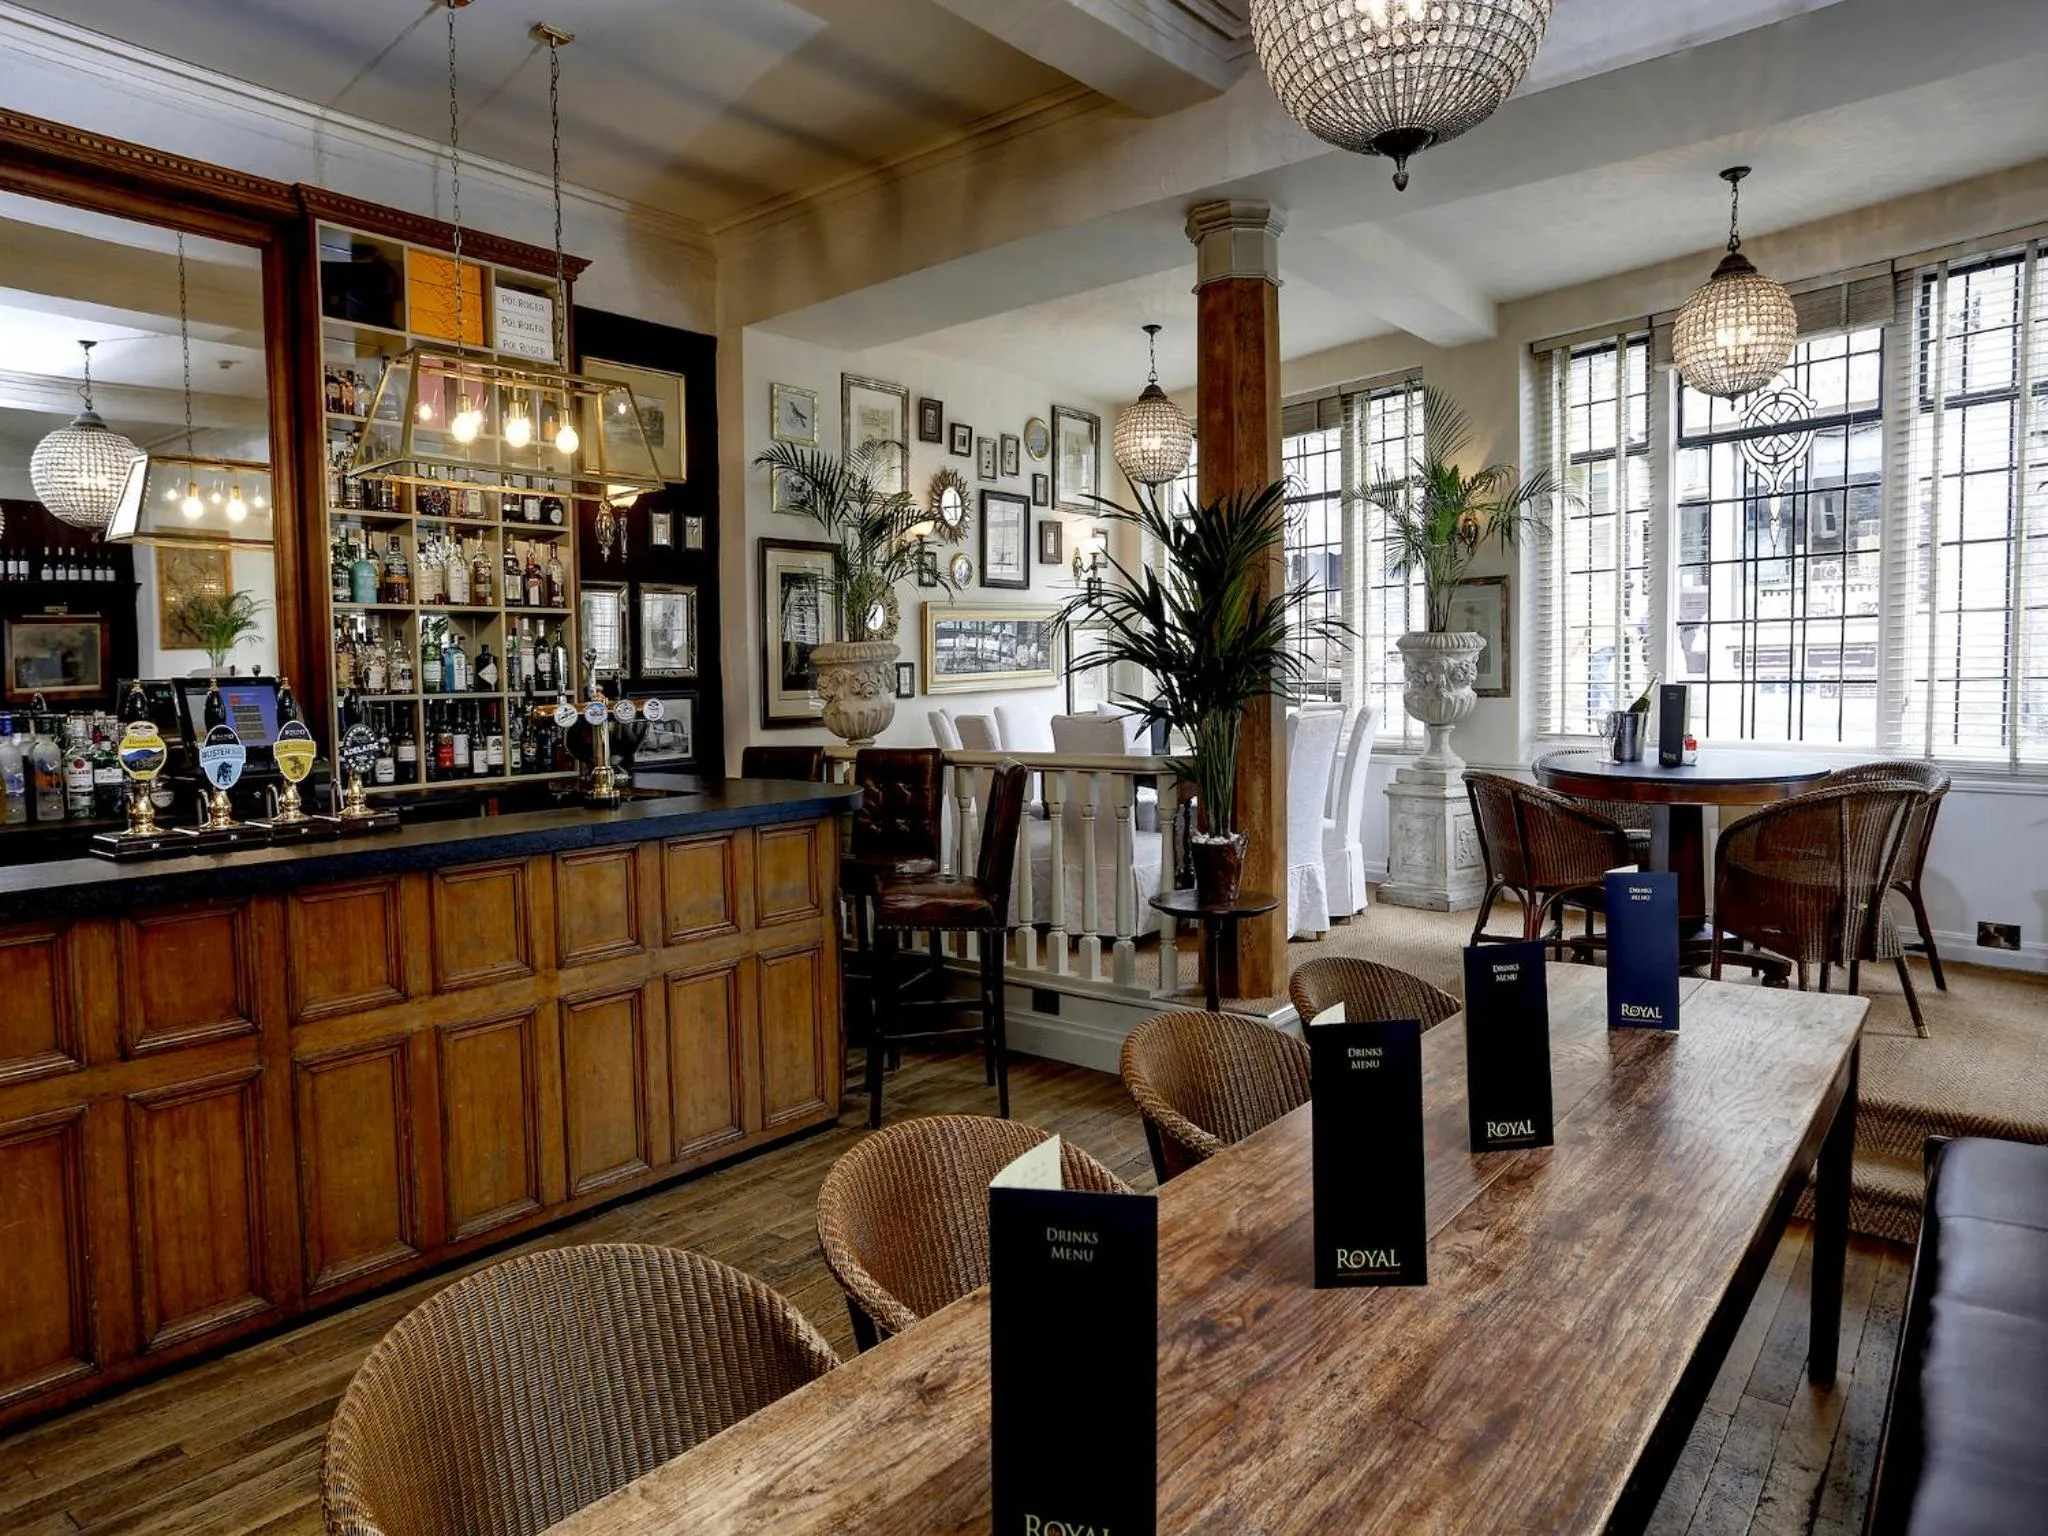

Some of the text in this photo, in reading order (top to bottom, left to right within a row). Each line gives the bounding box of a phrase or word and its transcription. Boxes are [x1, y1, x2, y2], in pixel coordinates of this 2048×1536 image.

[518, 299, 545, 312] ROGER
[518, 320, 545, 334] ROGER
[1621, 1003, 1663, 1019] ROYAL
[1487, 1119, 1536, 1138] ROYAL
[1336, 1248, 1401, 1269] ROYAL
